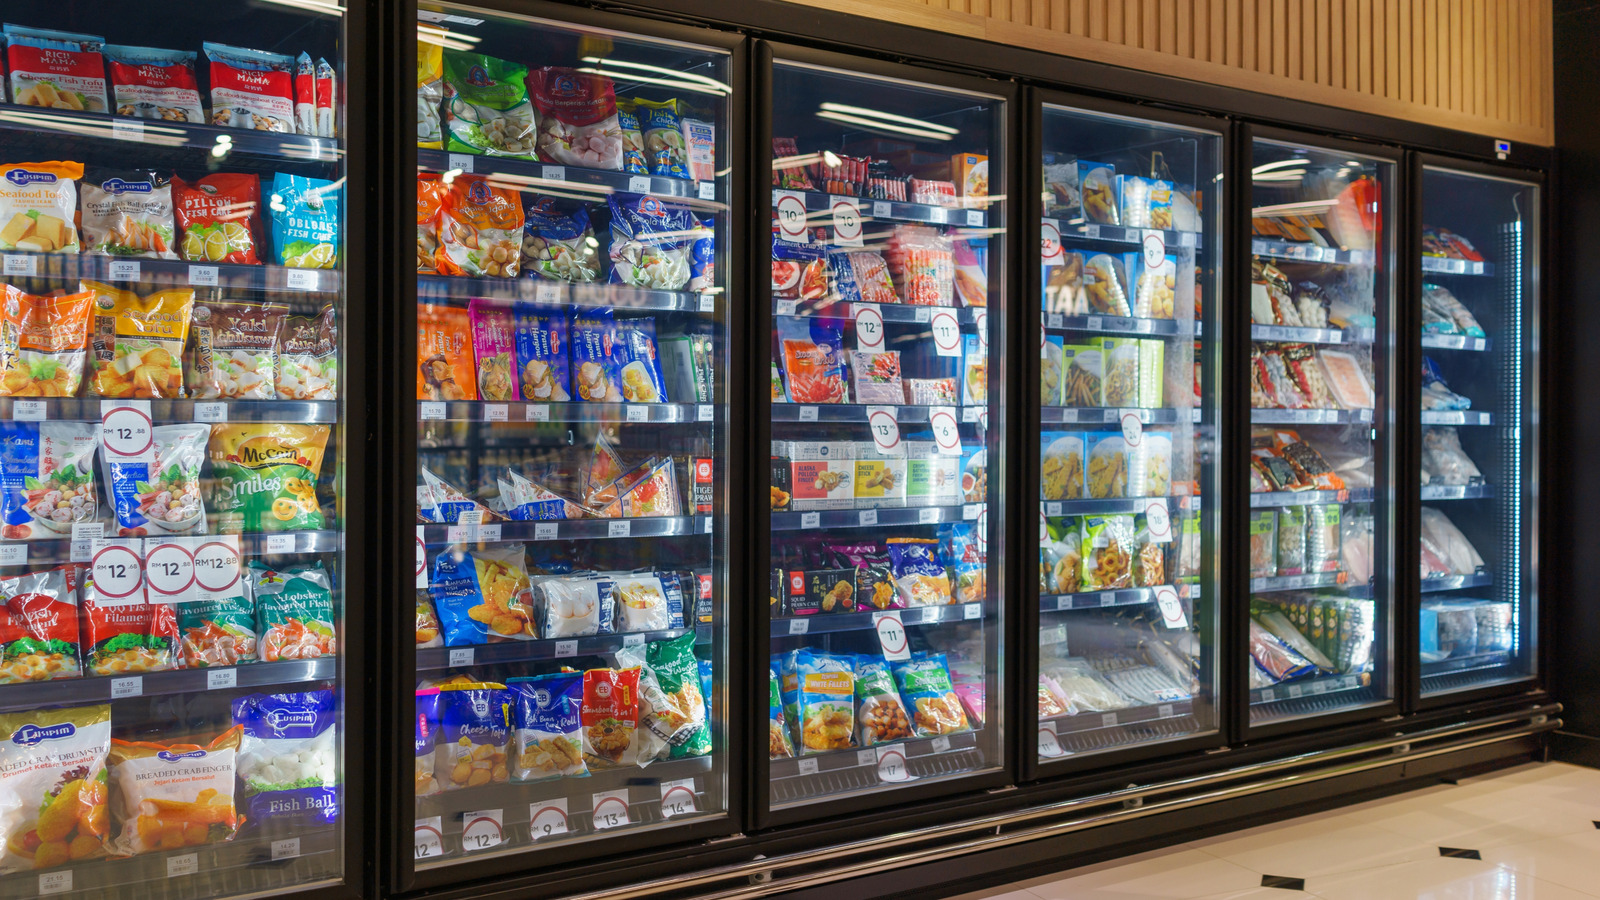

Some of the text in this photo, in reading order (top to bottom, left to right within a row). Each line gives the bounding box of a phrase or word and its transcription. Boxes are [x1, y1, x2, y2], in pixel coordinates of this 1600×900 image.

[45, 50, 71, 59] RICH
[40, 56, 78, 66] MAMA
[138, 69, 172, 81] MAMA
[142, 65, 166, 74] RICH
[19, 72, 104, 88] Cheese Fish Tofu
[237, 73, 270, 86] MAMA
[185, 199, 232, 210] PILLOW
[186, 209, 208, 219] FISH
[785, 209, 797, 222] 10
[287, 228, 309, 239] FISH
[227, 316, 269, 332] Yaki
[864, 322, 875, 333] 12
[436, 330, 445, 356] Prawn
[531, 327, 543, 359] Hargow
[541, 330, 550, 355] Prawn
[592, 333, 602, 358] Prawn
[117, 428, 132, 440] 12
[877, 425, 889, 436] 13
[942, 426, 949, 436] 6
[242, 446, 298, 464] McCain
[221, 474, 281, 500] Smiles
[108, 564, 127, 578] 12
[162, 562, 180, 576] 12
[284, 593, 323, 602] Lobster
[309, 600, 330, 609] Fish
[887, 630, 898, 641] 11
[810, 680, 829, 688] WHITE
[829, 679, 850, 688] FILLETS
[561, 715, 577, 727] Roll
[460, 723, 490, 736] Cheese
[61, 756, 95, 767] Bersalut
[135, 764, 233, 781] BREADED CRAB FINGER
[886, 766, 896, 776] 17
[270, 794, 333, 813] Fish Ball
[669, 802, 685, 814] 14
[603, 813, 619, 826] 13
[543, 823, 552, 835] 9
[474, 834, 491, 848] 12
[415, 843, 430, 858] 12
